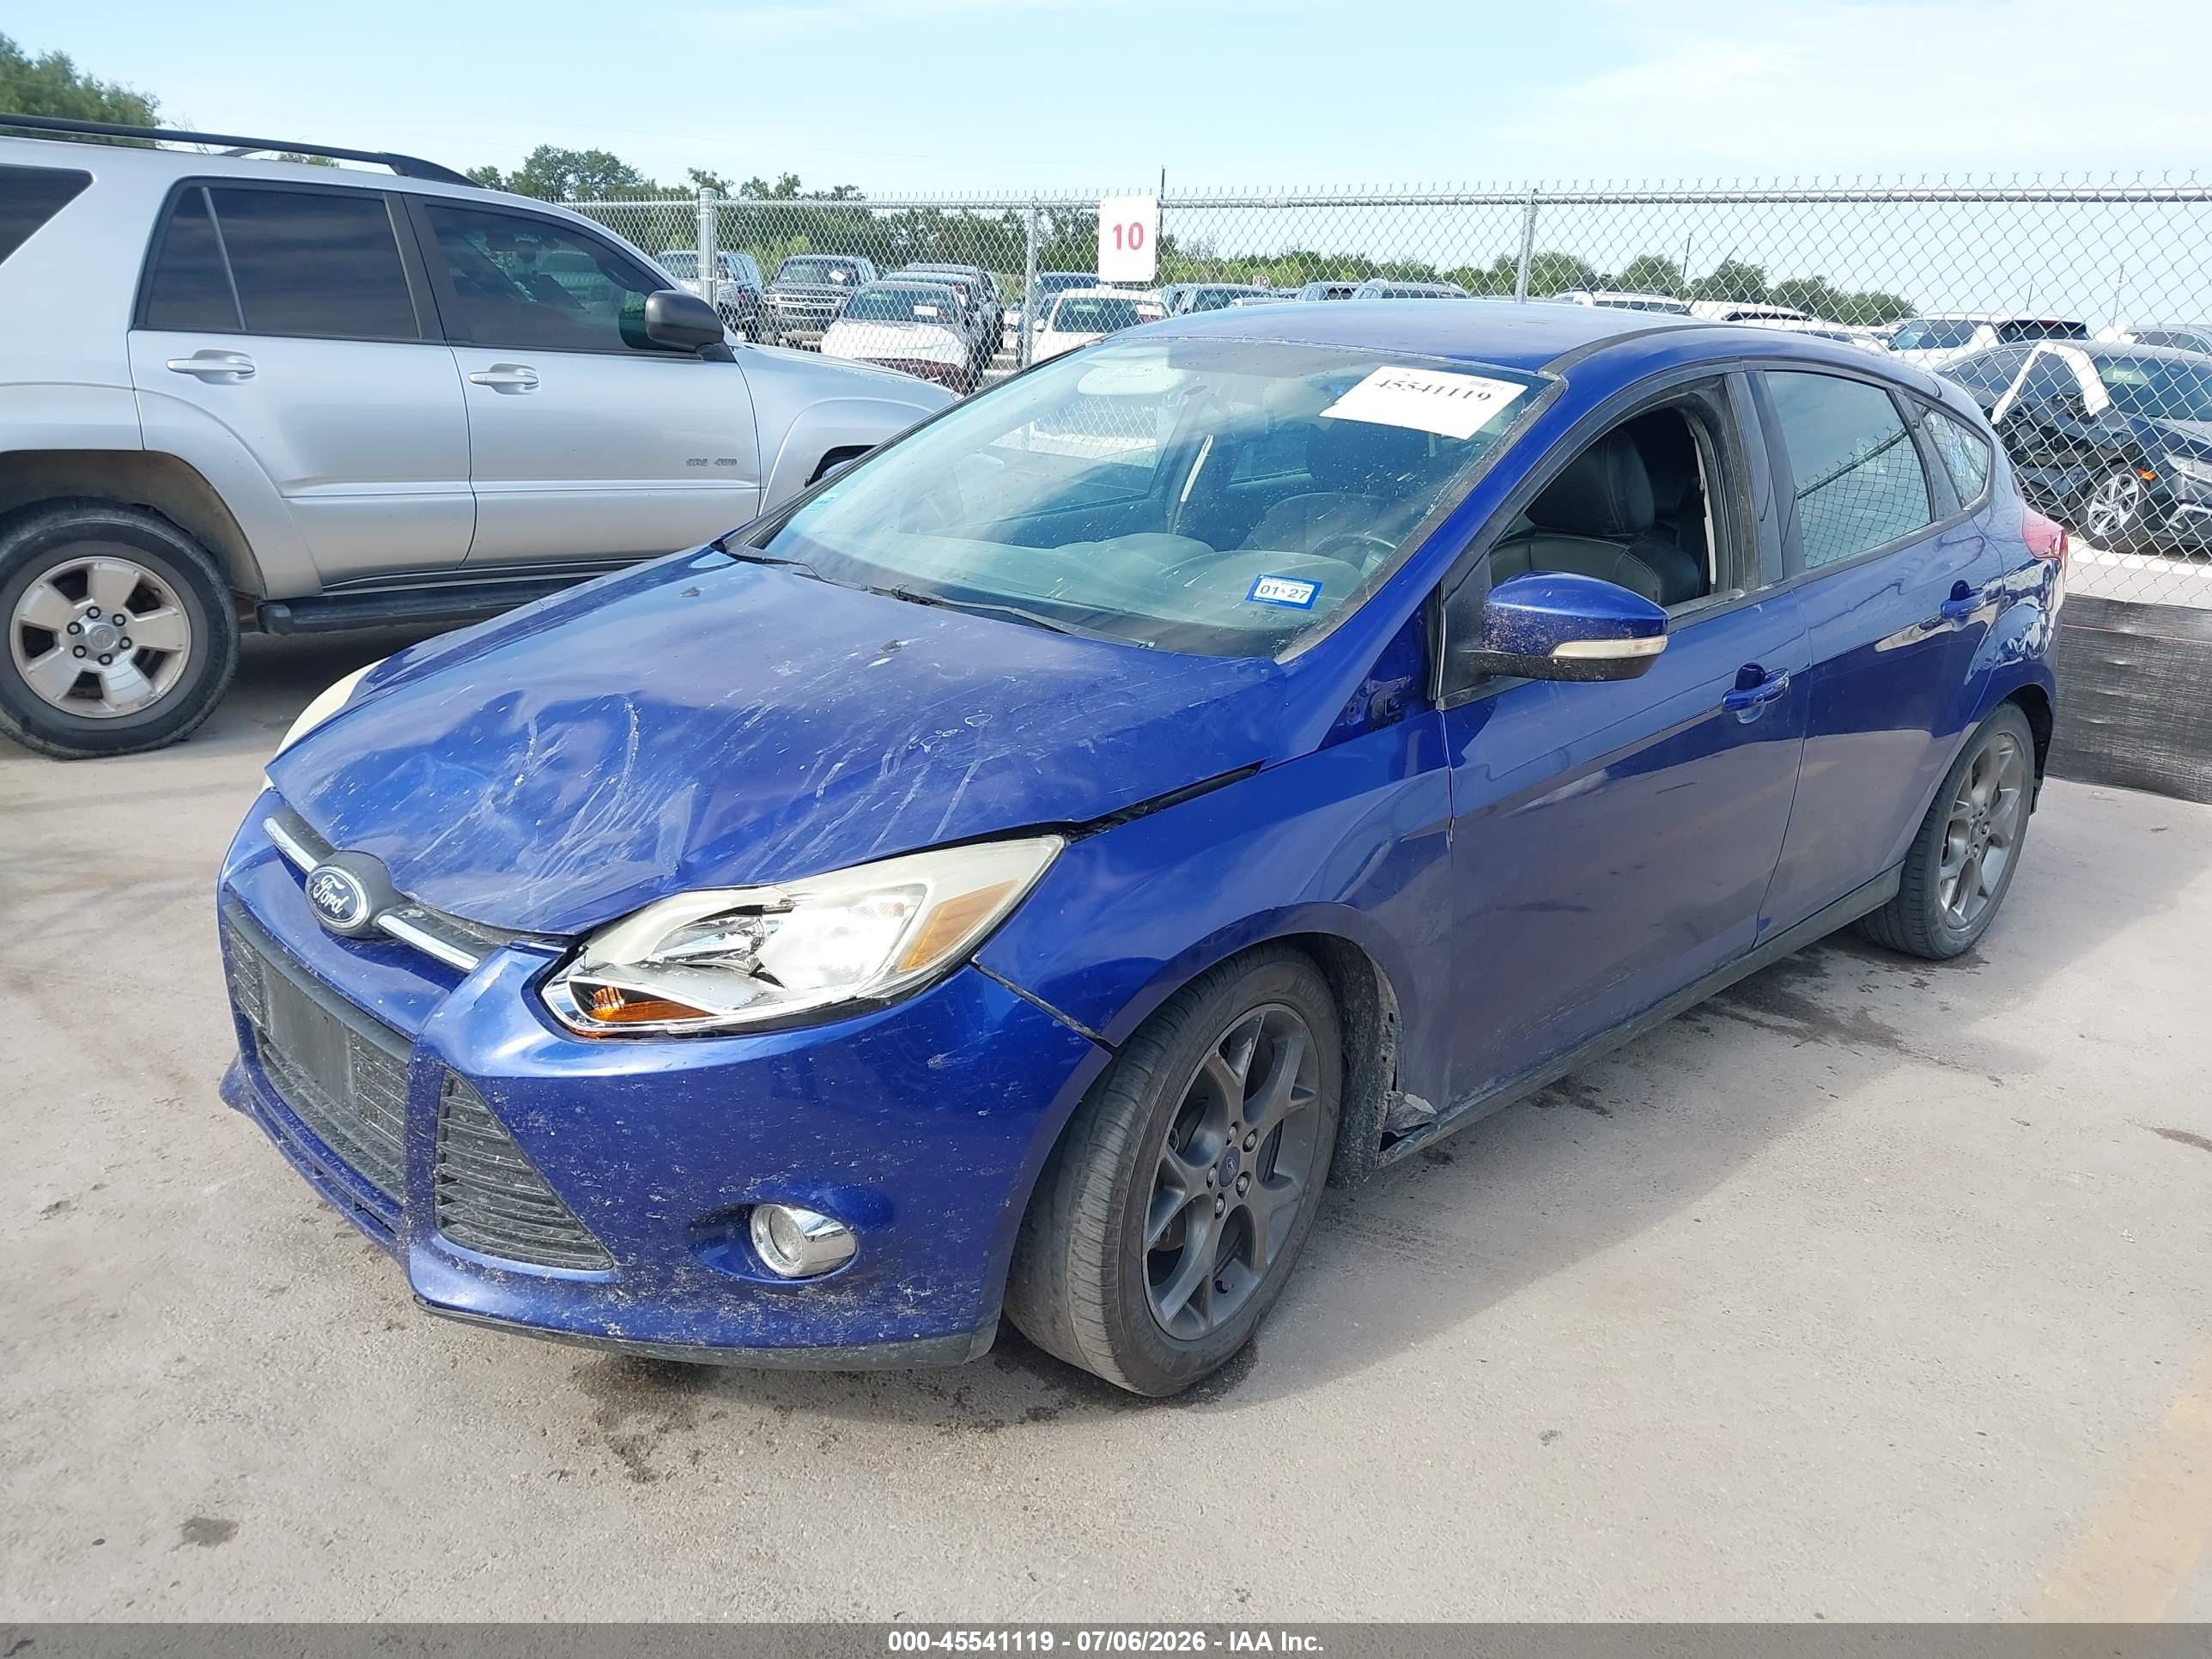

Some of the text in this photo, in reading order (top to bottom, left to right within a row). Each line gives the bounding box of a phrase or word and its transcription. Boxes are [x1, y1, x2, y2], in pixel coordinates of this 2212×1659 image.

[1113, 222, 1144, 250] 10
[1286, 588, 1310, 599] 27
[313, 874, 349, 914] Ford
